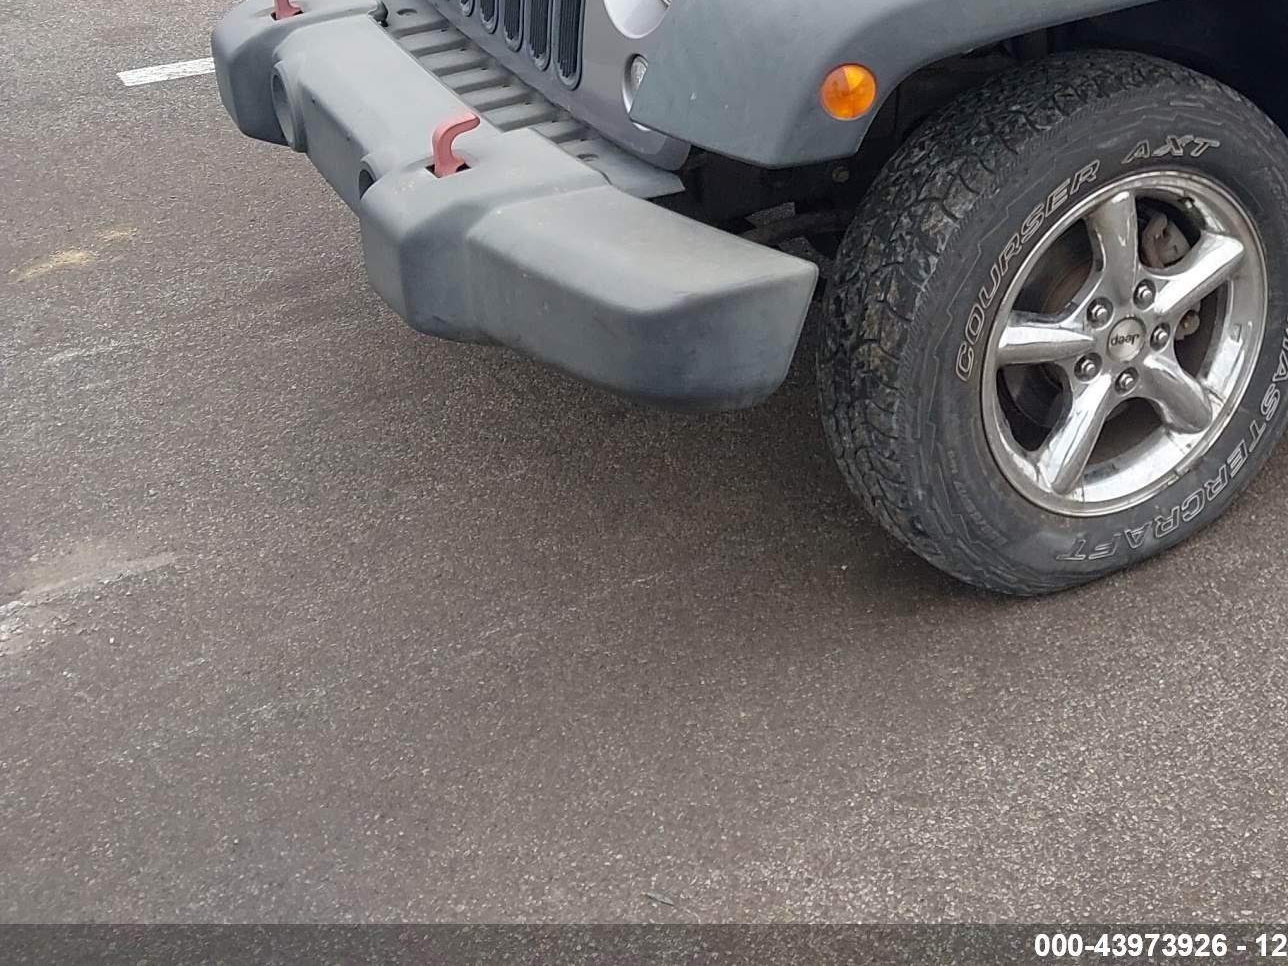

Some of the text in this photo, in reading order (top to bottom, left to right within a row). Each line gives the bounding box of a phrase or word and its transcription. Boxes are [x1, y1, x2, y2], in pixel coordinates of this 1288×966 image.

[954, 134, 1222, 383] COURSER AXT
[1110, 333, 1140, 346] Jeep
